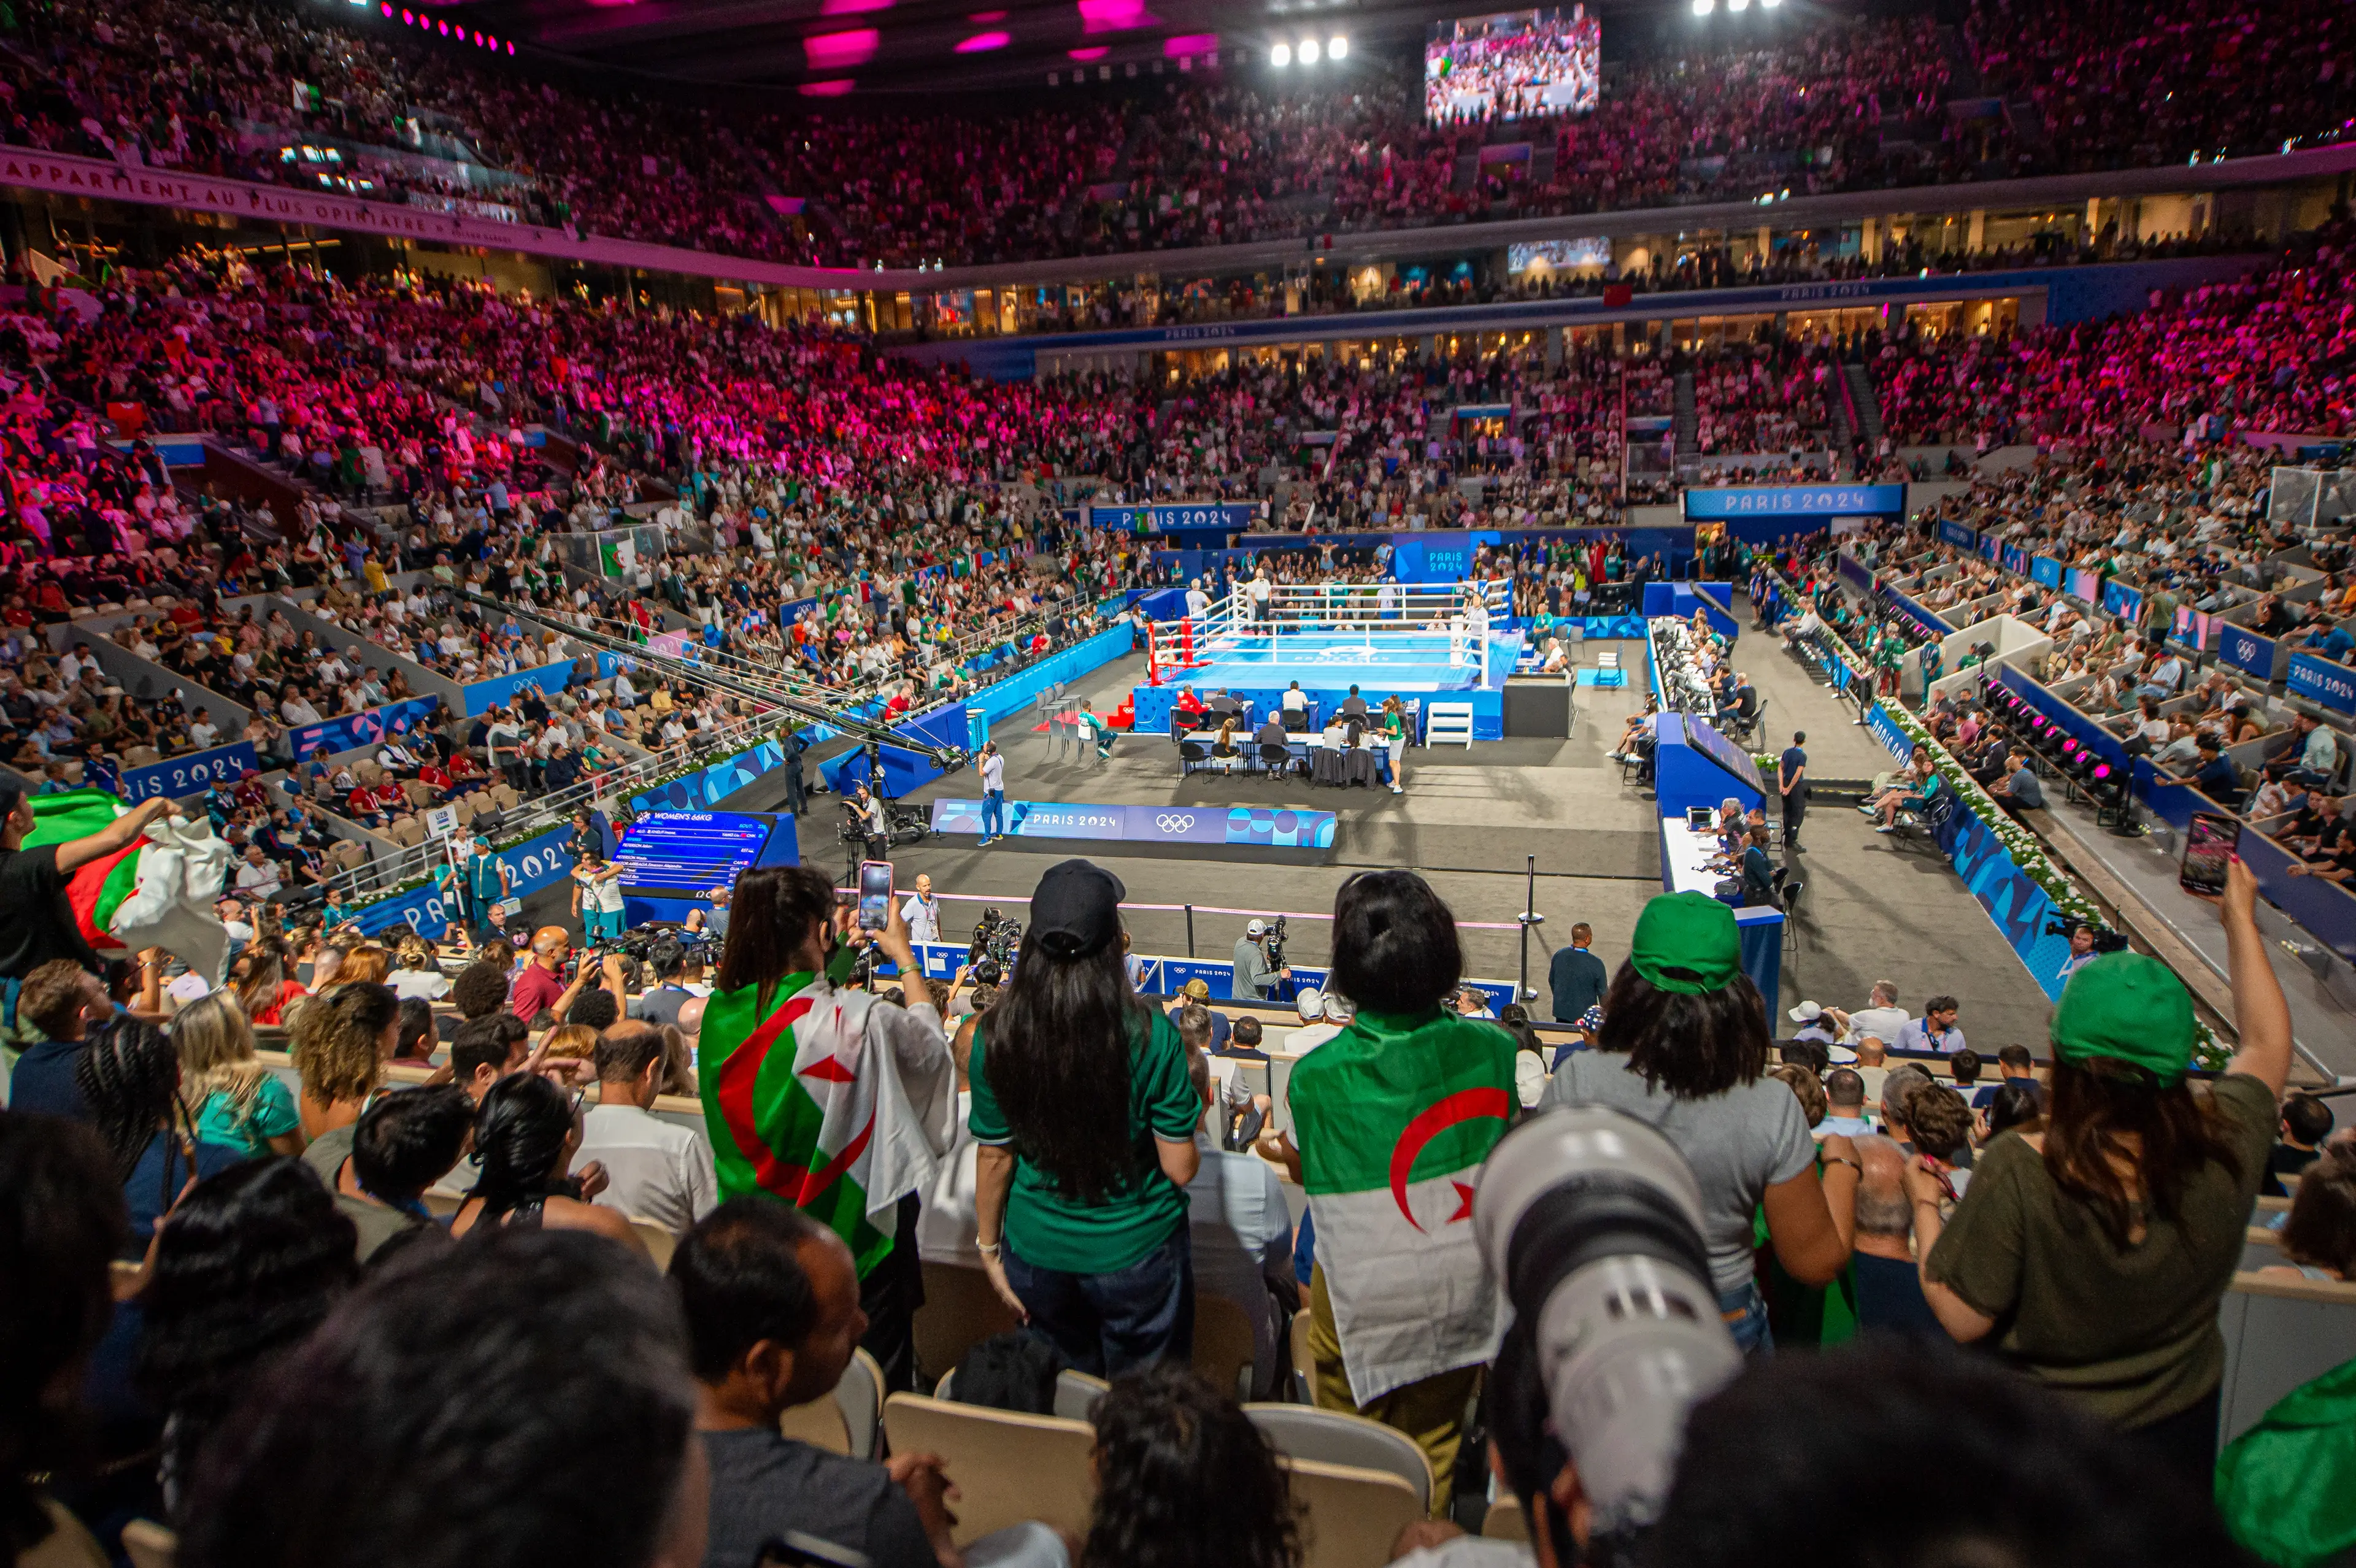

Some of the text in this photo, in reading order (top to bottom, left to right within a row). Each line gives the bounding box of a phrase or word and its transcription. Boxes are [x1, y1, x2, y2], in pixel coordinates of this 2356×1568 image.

[6, 161, 190, 201] APPARTIENT
[206, 190, 234, 206] AU
[251, 196, 304, 216] PLUS
[1726, 491, 1863, 510] PARIS 2024
[1122, 510, 1231, 525] PIS 2024
[1430, 552, 1462, 561] PARIS
[1430, 562, 1462, 571] 2024
[2294, 665, 2354, 699] PARIS 2024
[124, 756, 243, 799] RIS 2024
[435, 811, 448, 820] UZB
[1033, 814, 1116, 827] PARIS 2024
